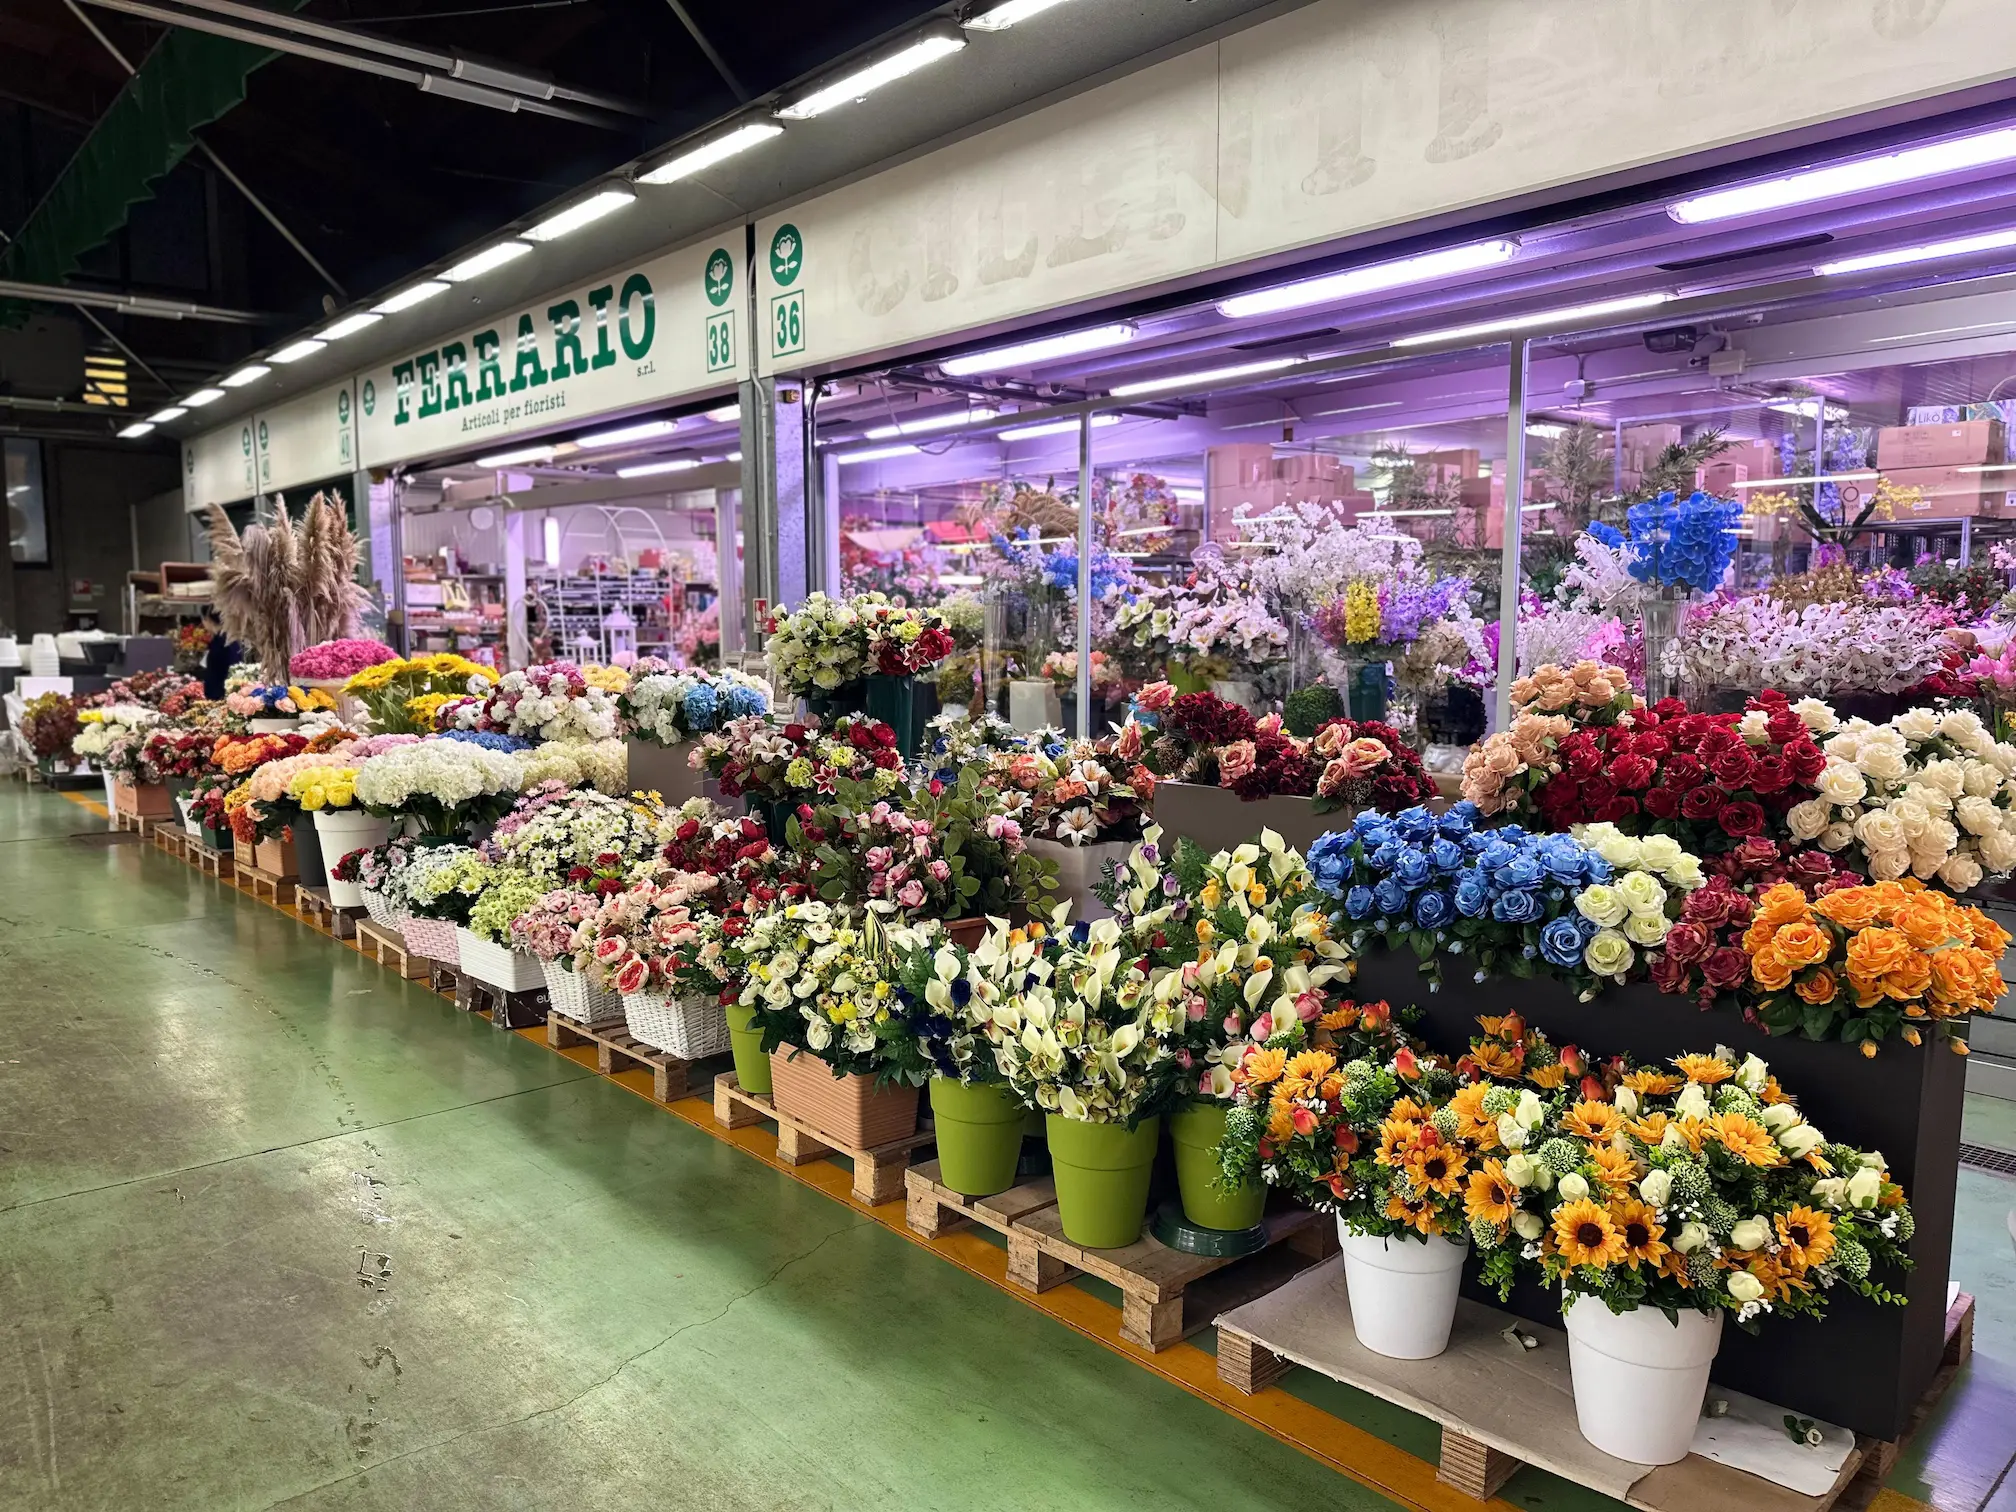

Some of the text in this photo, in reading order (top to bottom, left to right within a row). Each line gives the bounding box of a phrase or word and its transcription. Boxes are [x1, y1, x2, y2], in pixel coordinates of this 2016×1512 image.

[709, 321, 730, 366] 38
[777, 300, 800, 349] 36
[392, 273, 656, 426] FERRARIO
[637, 360, 656, 377] s.r.l.
[461, 391, 566, 432] Articoli per fioristi
